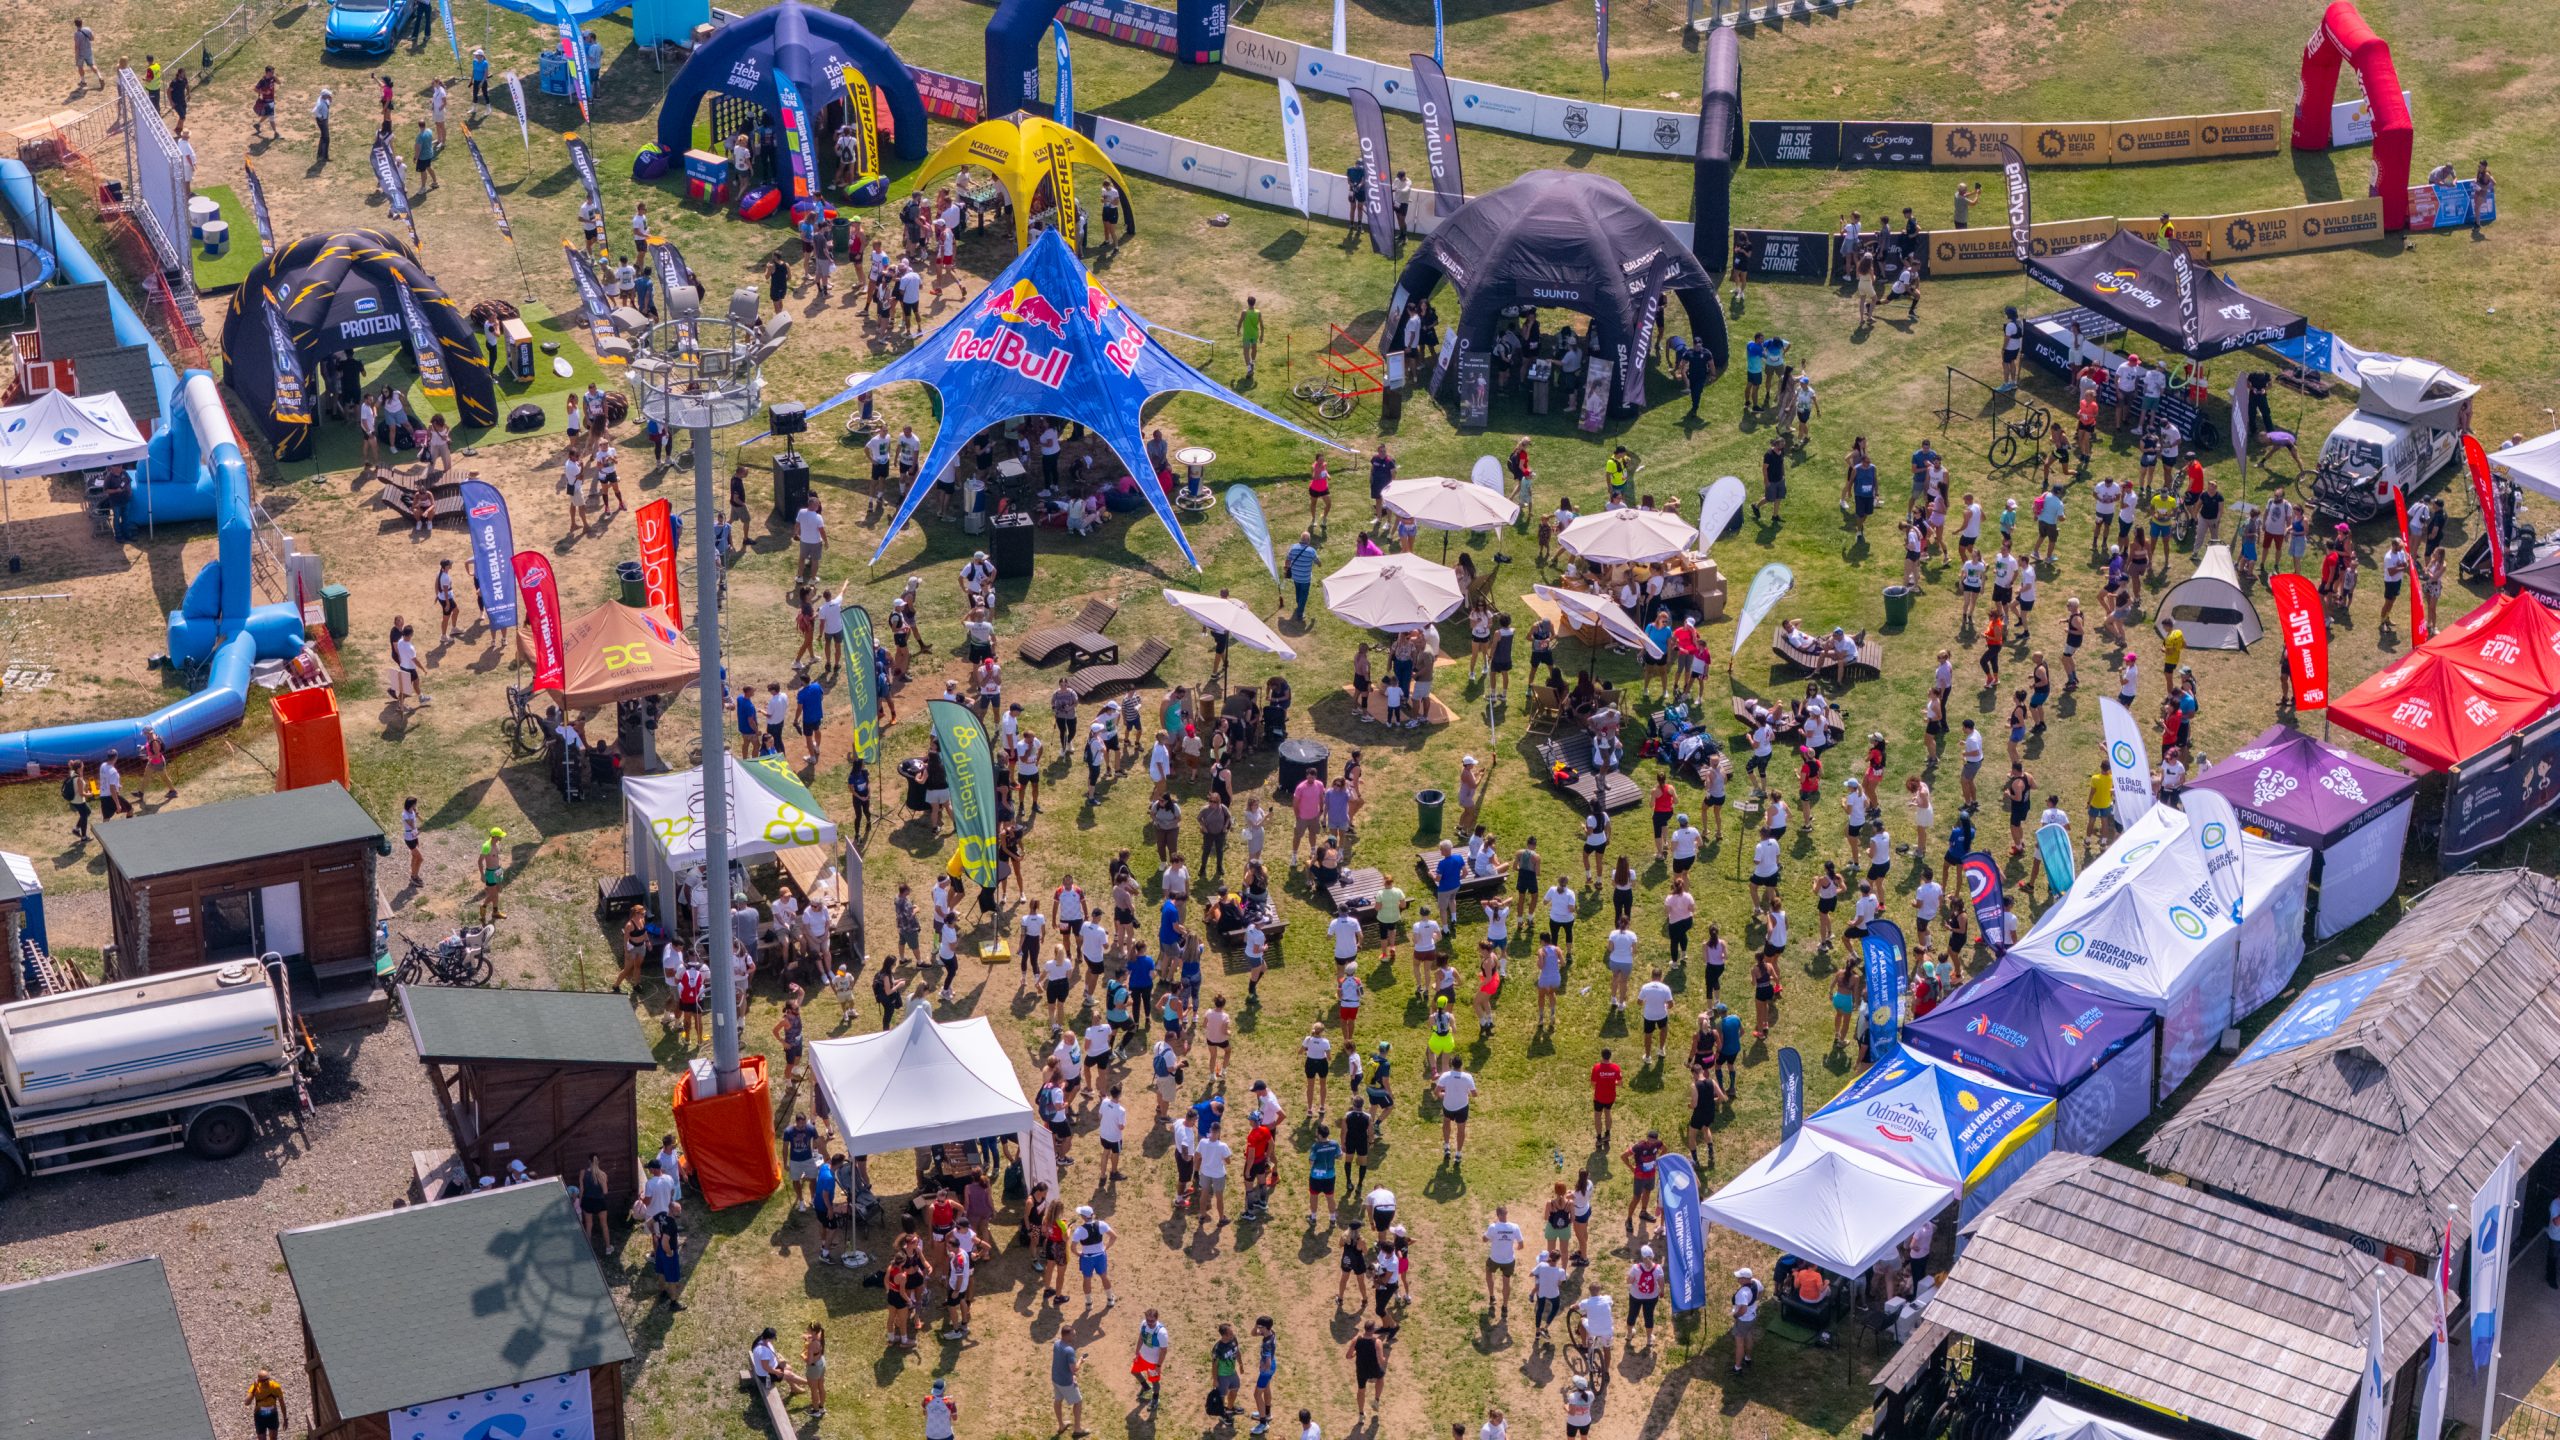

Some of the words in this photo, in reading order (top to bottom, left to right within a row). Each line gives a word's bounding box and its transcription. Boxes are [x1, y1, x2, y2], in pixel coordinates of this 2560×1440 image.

[1088, 4, 1112, 19] POBEDA
[1113, 12, 1132, 26] IZVOR
[1132, 17, 1154, 31] TVOJIH
[1153, 21, 1177, 37] POBEDA
[1209, 4, 1219, 37] Heba
[1236, 40, 1287, 66] GRAND
[731, 60, 760, 81] Heba
[727, 75, 758, 91] SPORT
[830, 78, 847, 90] SPO
[930, 85, 953, 102] TVOJIH
[952, 93, 978, 108] POBEDA
[1979, 133, 2009, 142] WILD
[2068, 133, 2095, 142] WILD
[2137, 132, 2163, 143] WILD
[2164, 130, 2190, 140] BEAR
[2221, 126, 2247, 135] WILD
[2248, 124, 2274, 133] BEAR
[1779, 133, 1793, 145] NA
[1794, 133, 1812, 145] SVE
[1884, 135, 1914, 145] cycling
[1980, 143, 2002, 152] BEA
[2068, 143, 2095, 152] BEAR
[1776, 147, 1812, 160] STRANE
[2257, 220, 2287, 231] WILD
[2323, 215, 2349, 226] WILD
[2351, 213, 2377, 223] BEAR
[2050, 236, 2077, 246] WILD
[2080, 233, 2107, 244] BEAR
[2176, 231, 2202, 240] BEAR
[2259, 229, 2287, 241] BEAR
[1765, 243, 1780, 255] NA
[1780, 243, 1800, 257] SVE
[1958, 243, 1986, 251] WILD
[1437, 252, 1464, 279] SUUNTO
[1761, 258, 1799, 271] STRANE
[2042, 273, 2064, 293] cycling
[2095, 270, 2113, 283] ris
[2120, 281, 2162, 308] cycling
[1533, 288, 1579, 300] SUUNTO
[356, 302, 376, 311] imlek
[2219, 303, 2251, 320] FOX
[340, 313, 402, 340] PROTEIN
[2245, 327, 2286, 344] cycling
[1104, 311, 1146, 379] Red
[2035, 343, 2049, 356] ris
[945, 326, 1005, 361] Red
[992, 328, 1073, 390] Bull
[2495, 634, 2518, 643] SERBIA
[2480, 639, 2520, 664] EPIC
[611, 666, 655, 679] GIGAGLIDE
[2408, 697, 2431, 708] SERBIA
[2391, 702, 2433, 729] EPIC
[2465, 700, 2498, 726] EPIC
[2365, 727, 2384, 740] SERBIA
[2386, 734, 2407, 754] EPIC
[2364, 800, 2395, 825] PROKUPAC
[2241, 810, 2286, 835] PROKUPAC
[2207, 850, 2233, 869] BELGRADE
[2085, 950, 2131, 971] MARATON
[2089, 939, 2148, 966] BEOGRADSKI
[2075, 1006, 2100, 1026] EUROPEAN
[2080, 1011, 2104, 1030] ATHLETICS
[1988, 1028, 2025, 1048] ATHLETICS
[1991, 1023, 2029, 1043] EUROPEAN
[1964, 1053, 1979, 1064] RUN
[1979, 1057, 2006, 1076] EUROPE
[1866, 1101, 1938, 1141] Odmenjska
[1890, 1123, 1907, 1132] VODA
[1958, 1122, 1978, 1143] TRKA
[1975, 1096, 2011, 1128] KRALJEVA
[1966, 1138, 1979, 1158] THE
[1977, 1122, 1996, 1146] RACE
[1993, 1116, 2005, 1131] OF
[2002, 1101, 2025, 1123] KINGS
